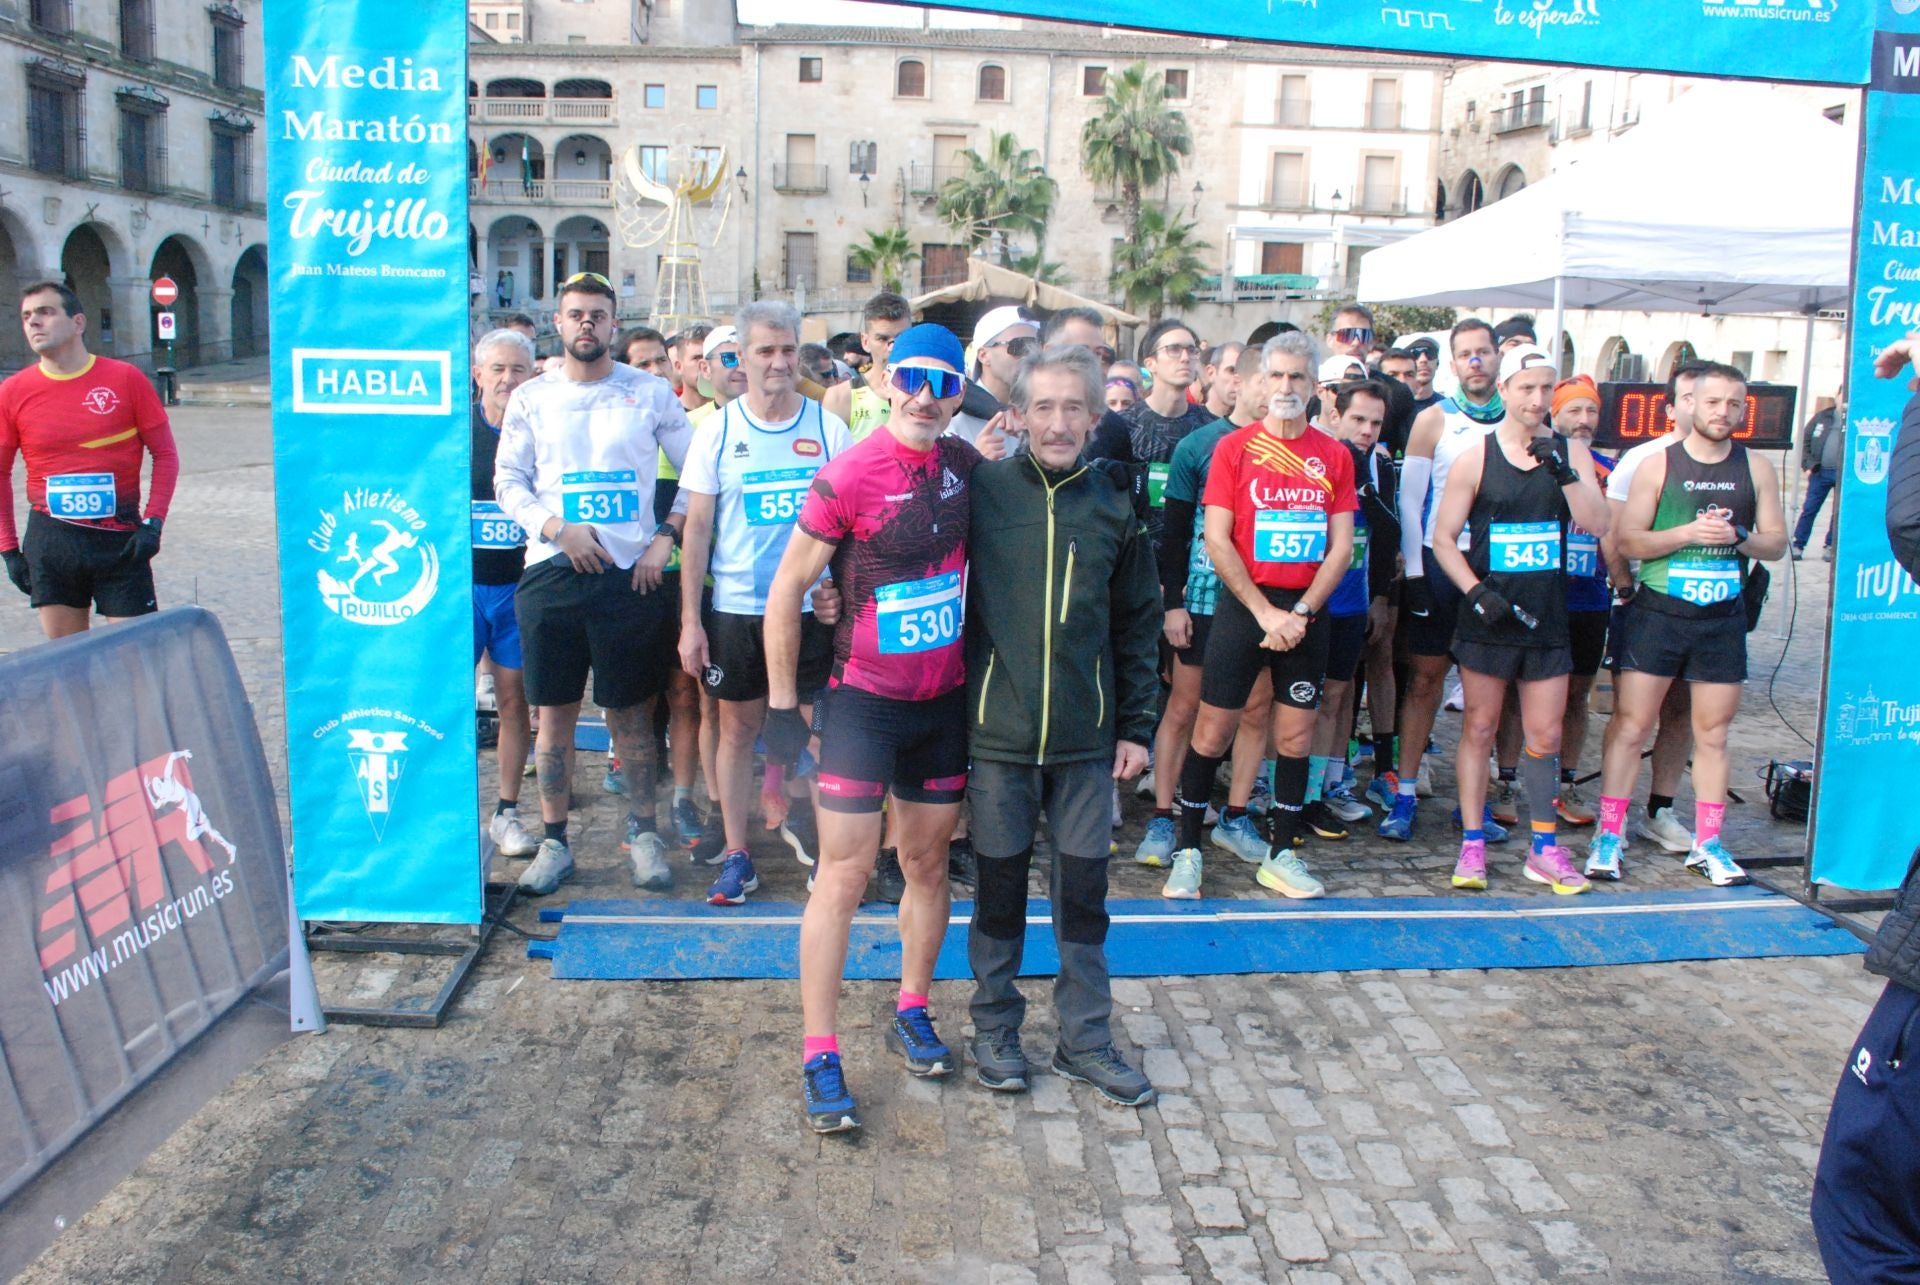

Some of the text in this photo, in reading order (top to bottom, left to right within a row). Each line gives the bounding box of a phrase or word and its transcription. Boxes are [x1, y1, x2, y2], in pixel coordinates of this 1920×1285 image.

[1494, 6, 1512, 26] te
[1702, 3, 1830, 23] www.musicrun.es
[291, 55, 441, 92] Media
[282, 110, 450, 144] Maratón
[305, 156, 430, 185] Ciudad de
[283, 189, 449, 257] Trujillo
[290, 263, 446, 279] Juan Mateos Broncano
[317, 369, 429, 396] HABLA
[61, 493, 102, 513] 589
[578, 492, 623, 520] 531
[1263, 487, 1326, 503] LAWDE
[307, 487, 427, 552] Club Atletismo
[481, 521, 522, 542] 588
[1269, 532, 1316, 558] 557
[1504, 543, 1549, 568] 543
[1682, 579, 1729, 603] 560
[329, 593, 413, 618] TRUJILLO
[899, 605, 954, 647] 530
[312, 719, 340, 739] Club
[341, 707, 392, 723] Athletico
[393, 710, 416, 725] San
[43, 869, 235, 1006] www.musicrun.es
